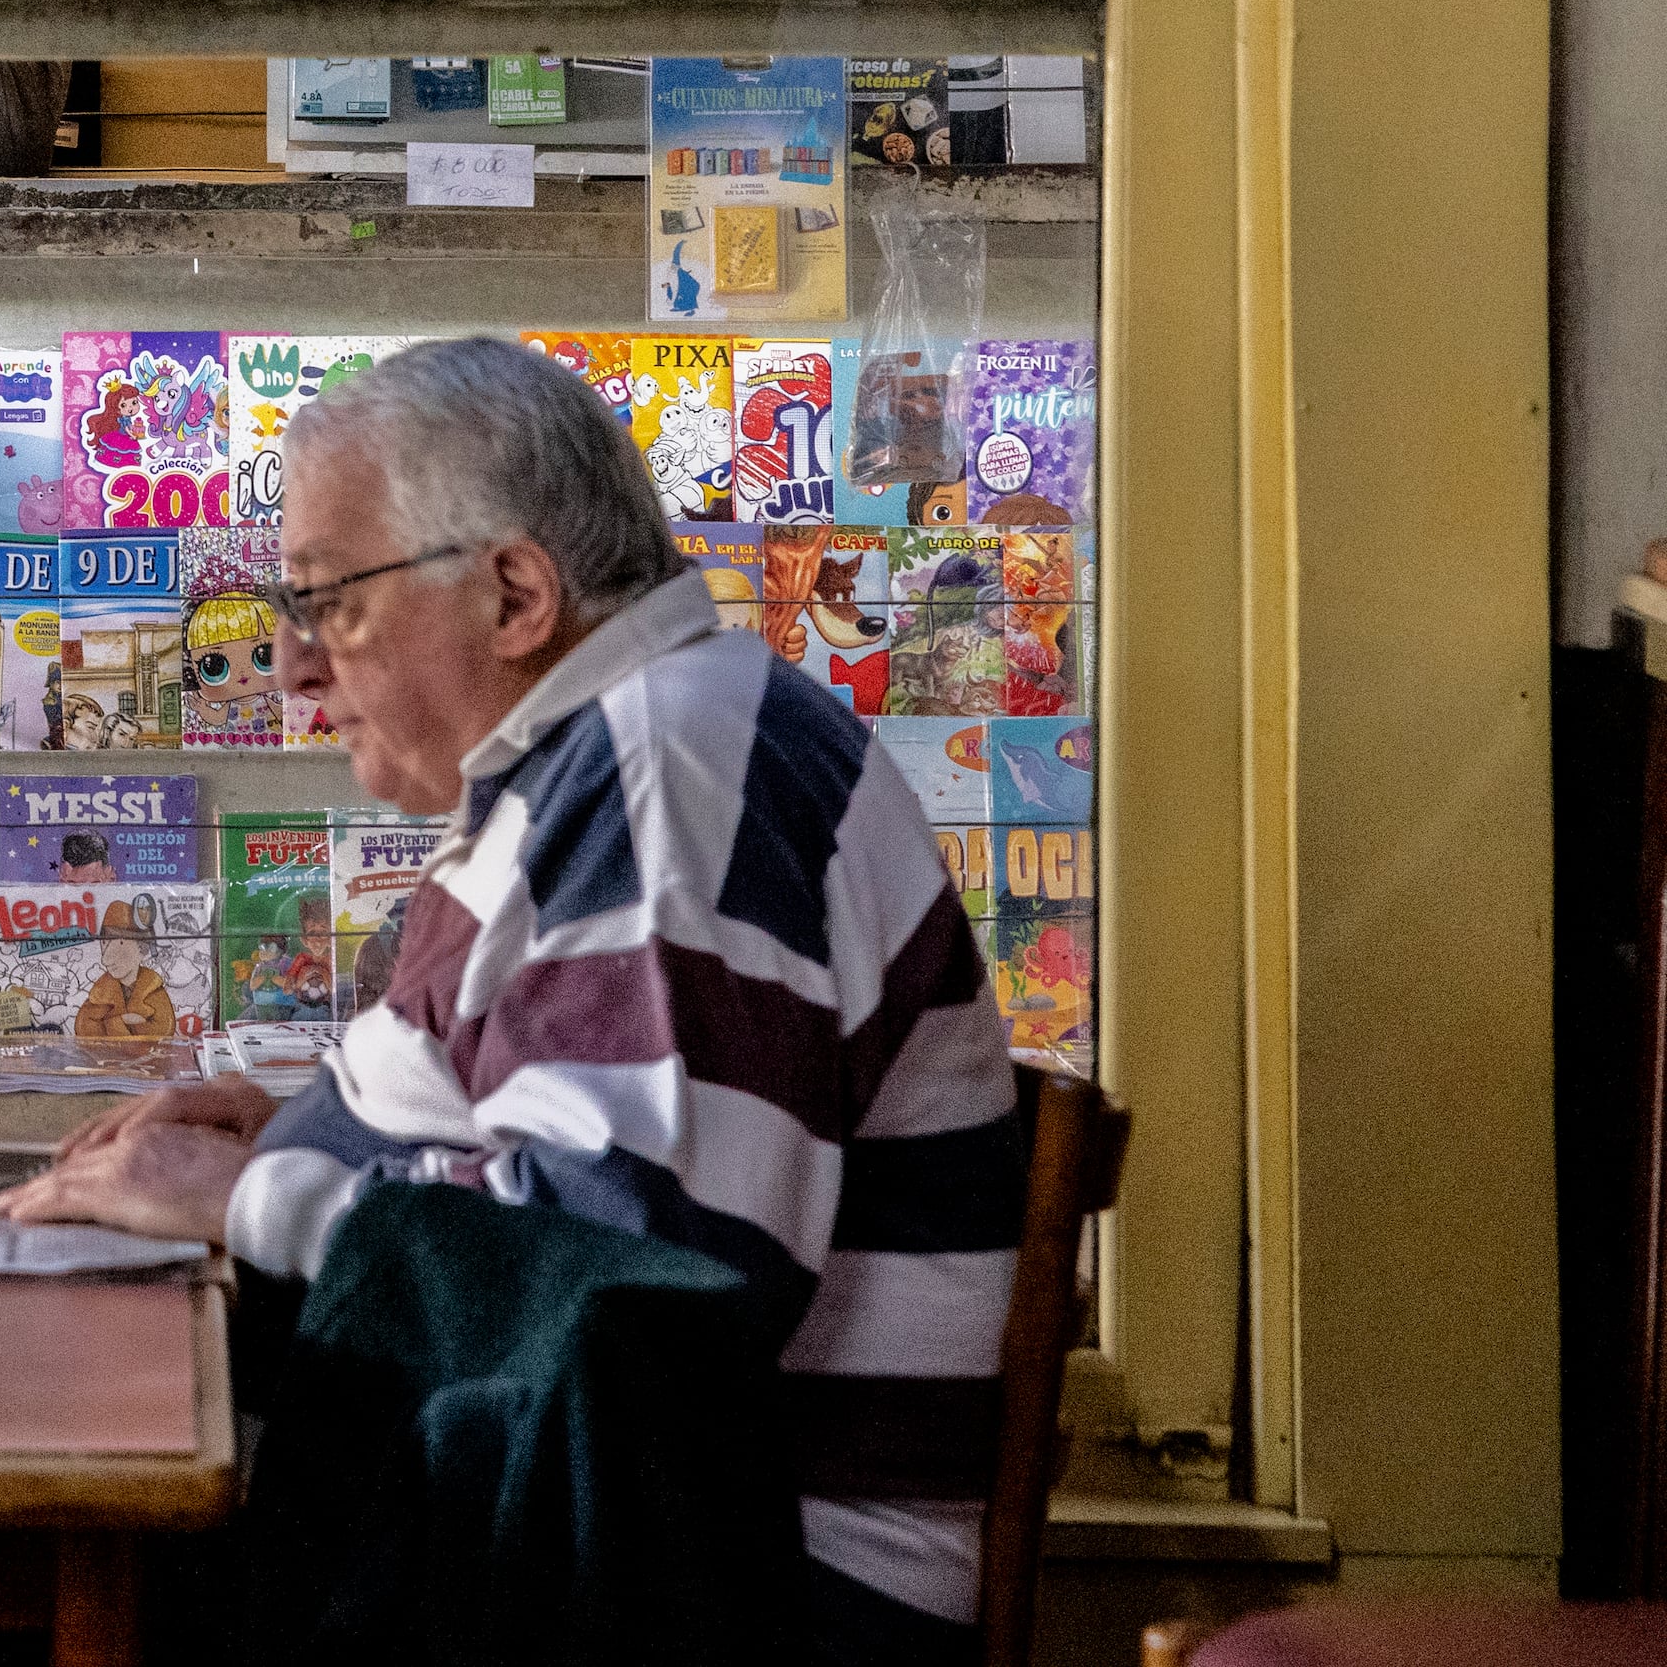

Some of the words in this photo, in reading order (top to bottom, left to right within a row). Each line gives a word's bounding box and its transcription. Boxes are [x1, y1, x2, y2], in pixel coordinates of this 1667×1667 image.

[500, 90, 533, 101] CABLE
[672, 87, 736, 108] CUENTOS
[654, 345, 731, 367] PIXA
[1003, 344, 1031, 355] Disney
[747, 359, 815, 375] SPIDEY
[977, 355, 1041, 371] FROZEN
[1044, 355, 1056, 372] II
[252, 370, 293, 388] Dino
[4, 412, 29, 422] Lengua
[987, 448, 1019, 461] PÁGINAS
[150, 458, 203, 475] Colección
[980, 461, 1001, 472] PARA
[1002, 453, 1029, 467] LLENAR
[927, 537, 974, 550] LIBRO
[980, 537, 999, 550] DE
[5, 554, 51, 591] DE
[26, 789, 168, 826] MESSI
[115, 831, 186, 845] CAMPEÓN
[138, 848, 164, 861] DEL
[125, 863, 178, 876] MUNDO
[359, 879, 373, 889] Se
[187, 1018, 195, 1031] 1
